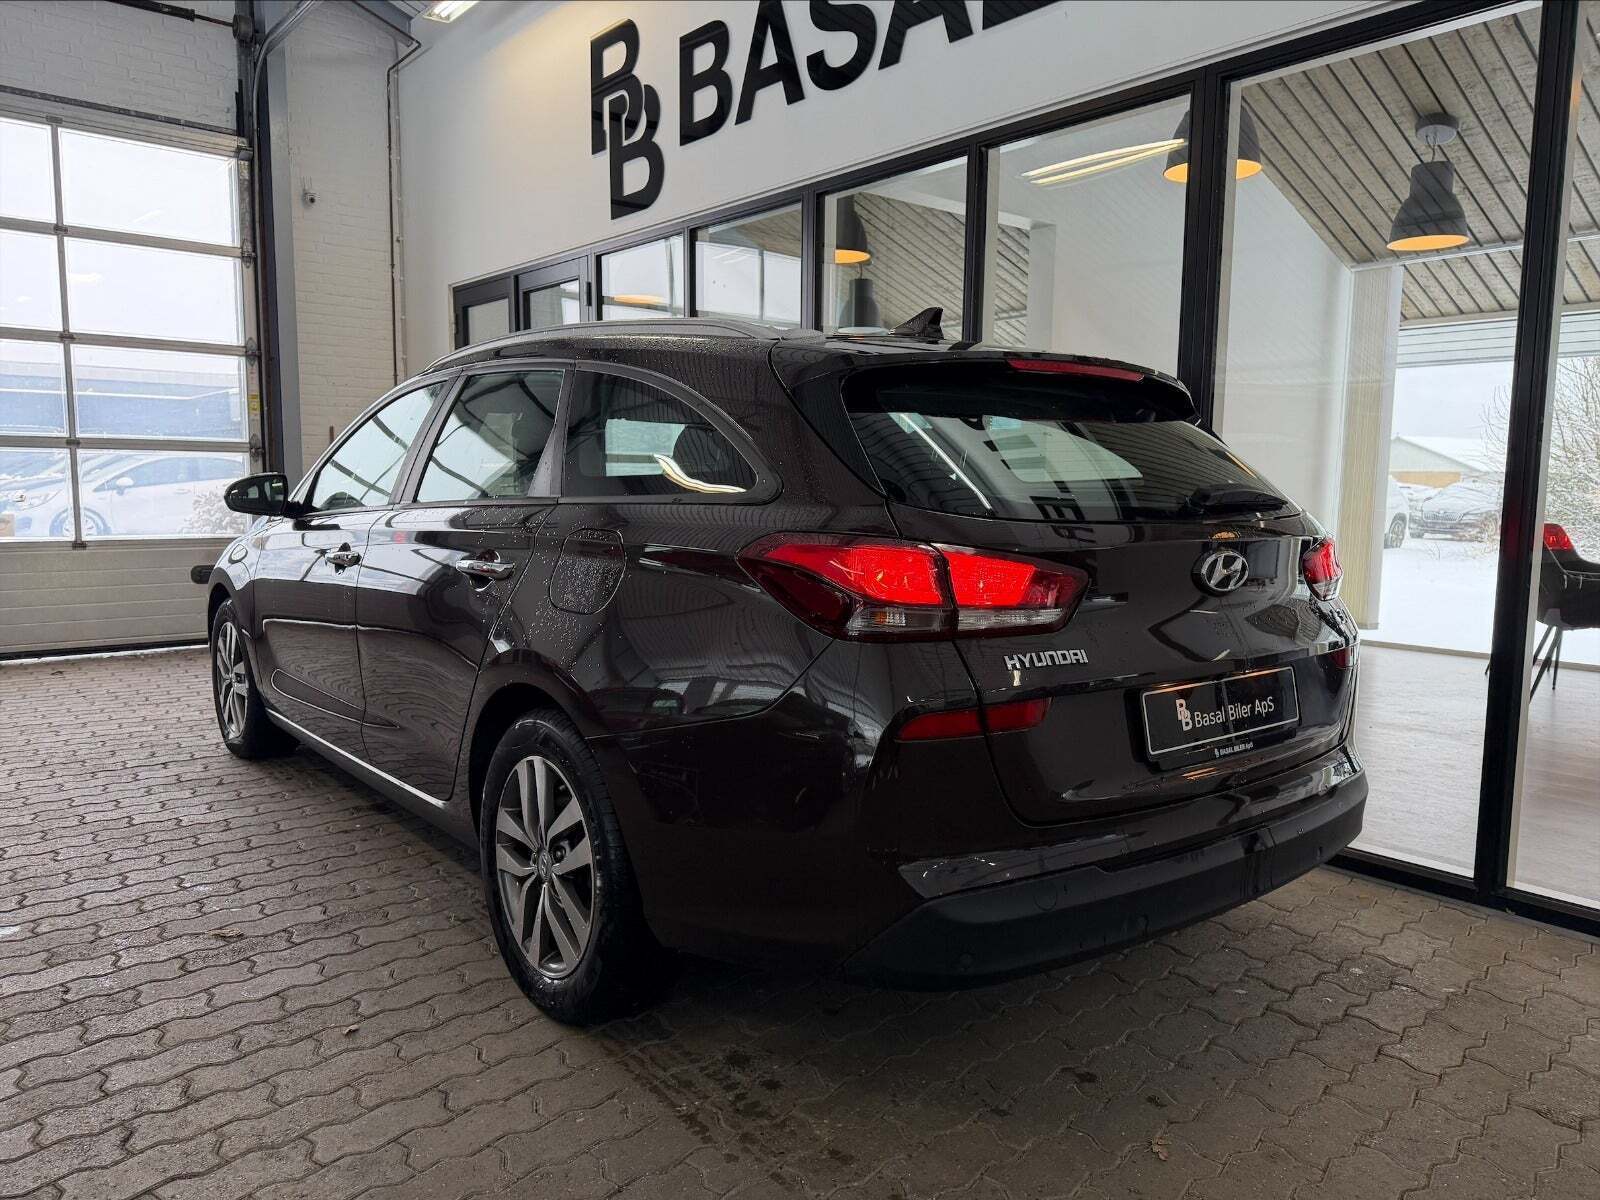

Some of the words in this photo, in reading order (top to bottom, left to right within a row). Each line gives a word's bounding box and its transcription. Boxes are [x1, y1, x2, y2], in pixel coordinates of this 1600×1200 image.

[679, 0, 1062, 147] BASA
[1003, 649, 1089, 670] HYUNDAI
[1194, 706, 1226, 728] Basal
[1227, 703, 1251, 720] Biler
[1254, 696, 1275, 717] ApS
